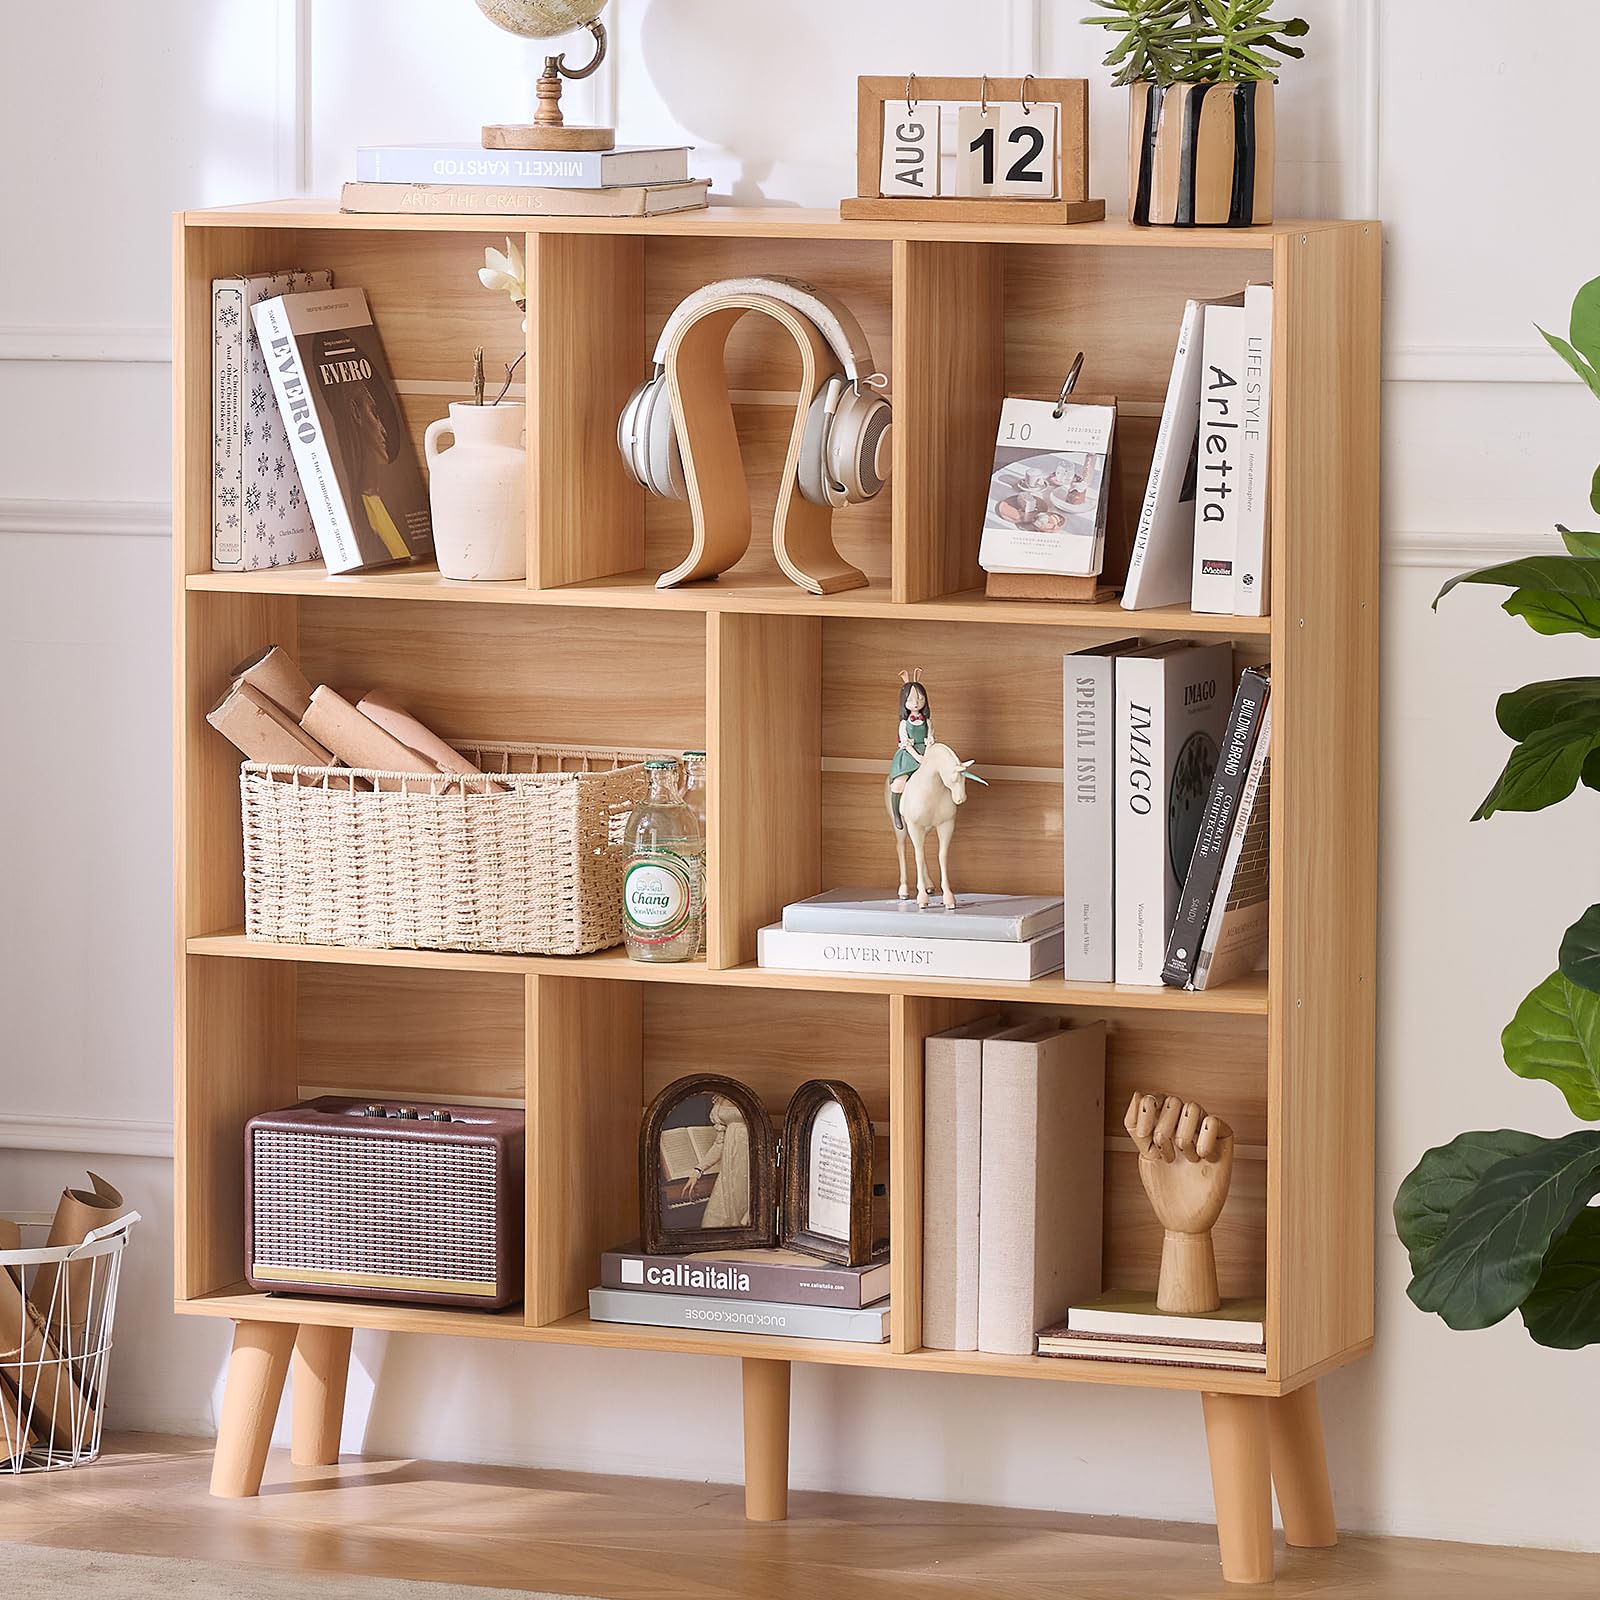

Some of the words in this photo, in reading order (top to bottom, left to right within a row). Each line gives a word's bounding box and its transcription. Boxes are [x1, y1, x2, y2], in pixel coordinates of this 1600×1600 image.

[433, 159, 509, 176] KARSTOD
[514, 160, 583, 177] MIKKETL
[895, 122, 925, 188] AUG
[969, 125, 1045, 185] 12
[401, 192, 440, 207] ARTS
[485, 194, 543, 209] CRAFTS
[319, 358, 372, 386] EVERO
[1247, 337, 1262, 377] LIFE
[271, 336, 317, 444] EVERO
[1006, 422, 1032, 441] 10
[1244, 383, 1261, 441] STYLE
[1202, 365, 1238, 522] Arletta
[1137, 490, 1157, 550] KINFOLK
[1151, 467, 1161, 489] HOME
[1076, 677, 1095, 748] SPECIAL
[1184, 680, 1216, 706] IMAGO
[1129, 701, 1152, 815] IMAGO
[1077, 757, 1096, 803] ISSUE
[1199, 783, 1225, 858] ARCHITECTURE
[1211, 794, 1233, 853] CORPORATE
[1234, 808, 1249, 838] HOME
[630, 891, 670, 908] Chang
[823, 945, 881, 962] OLIVER
[884, 948, 934, 965] TWIST
[647, 1264, 750, 1291] caliaitalia
